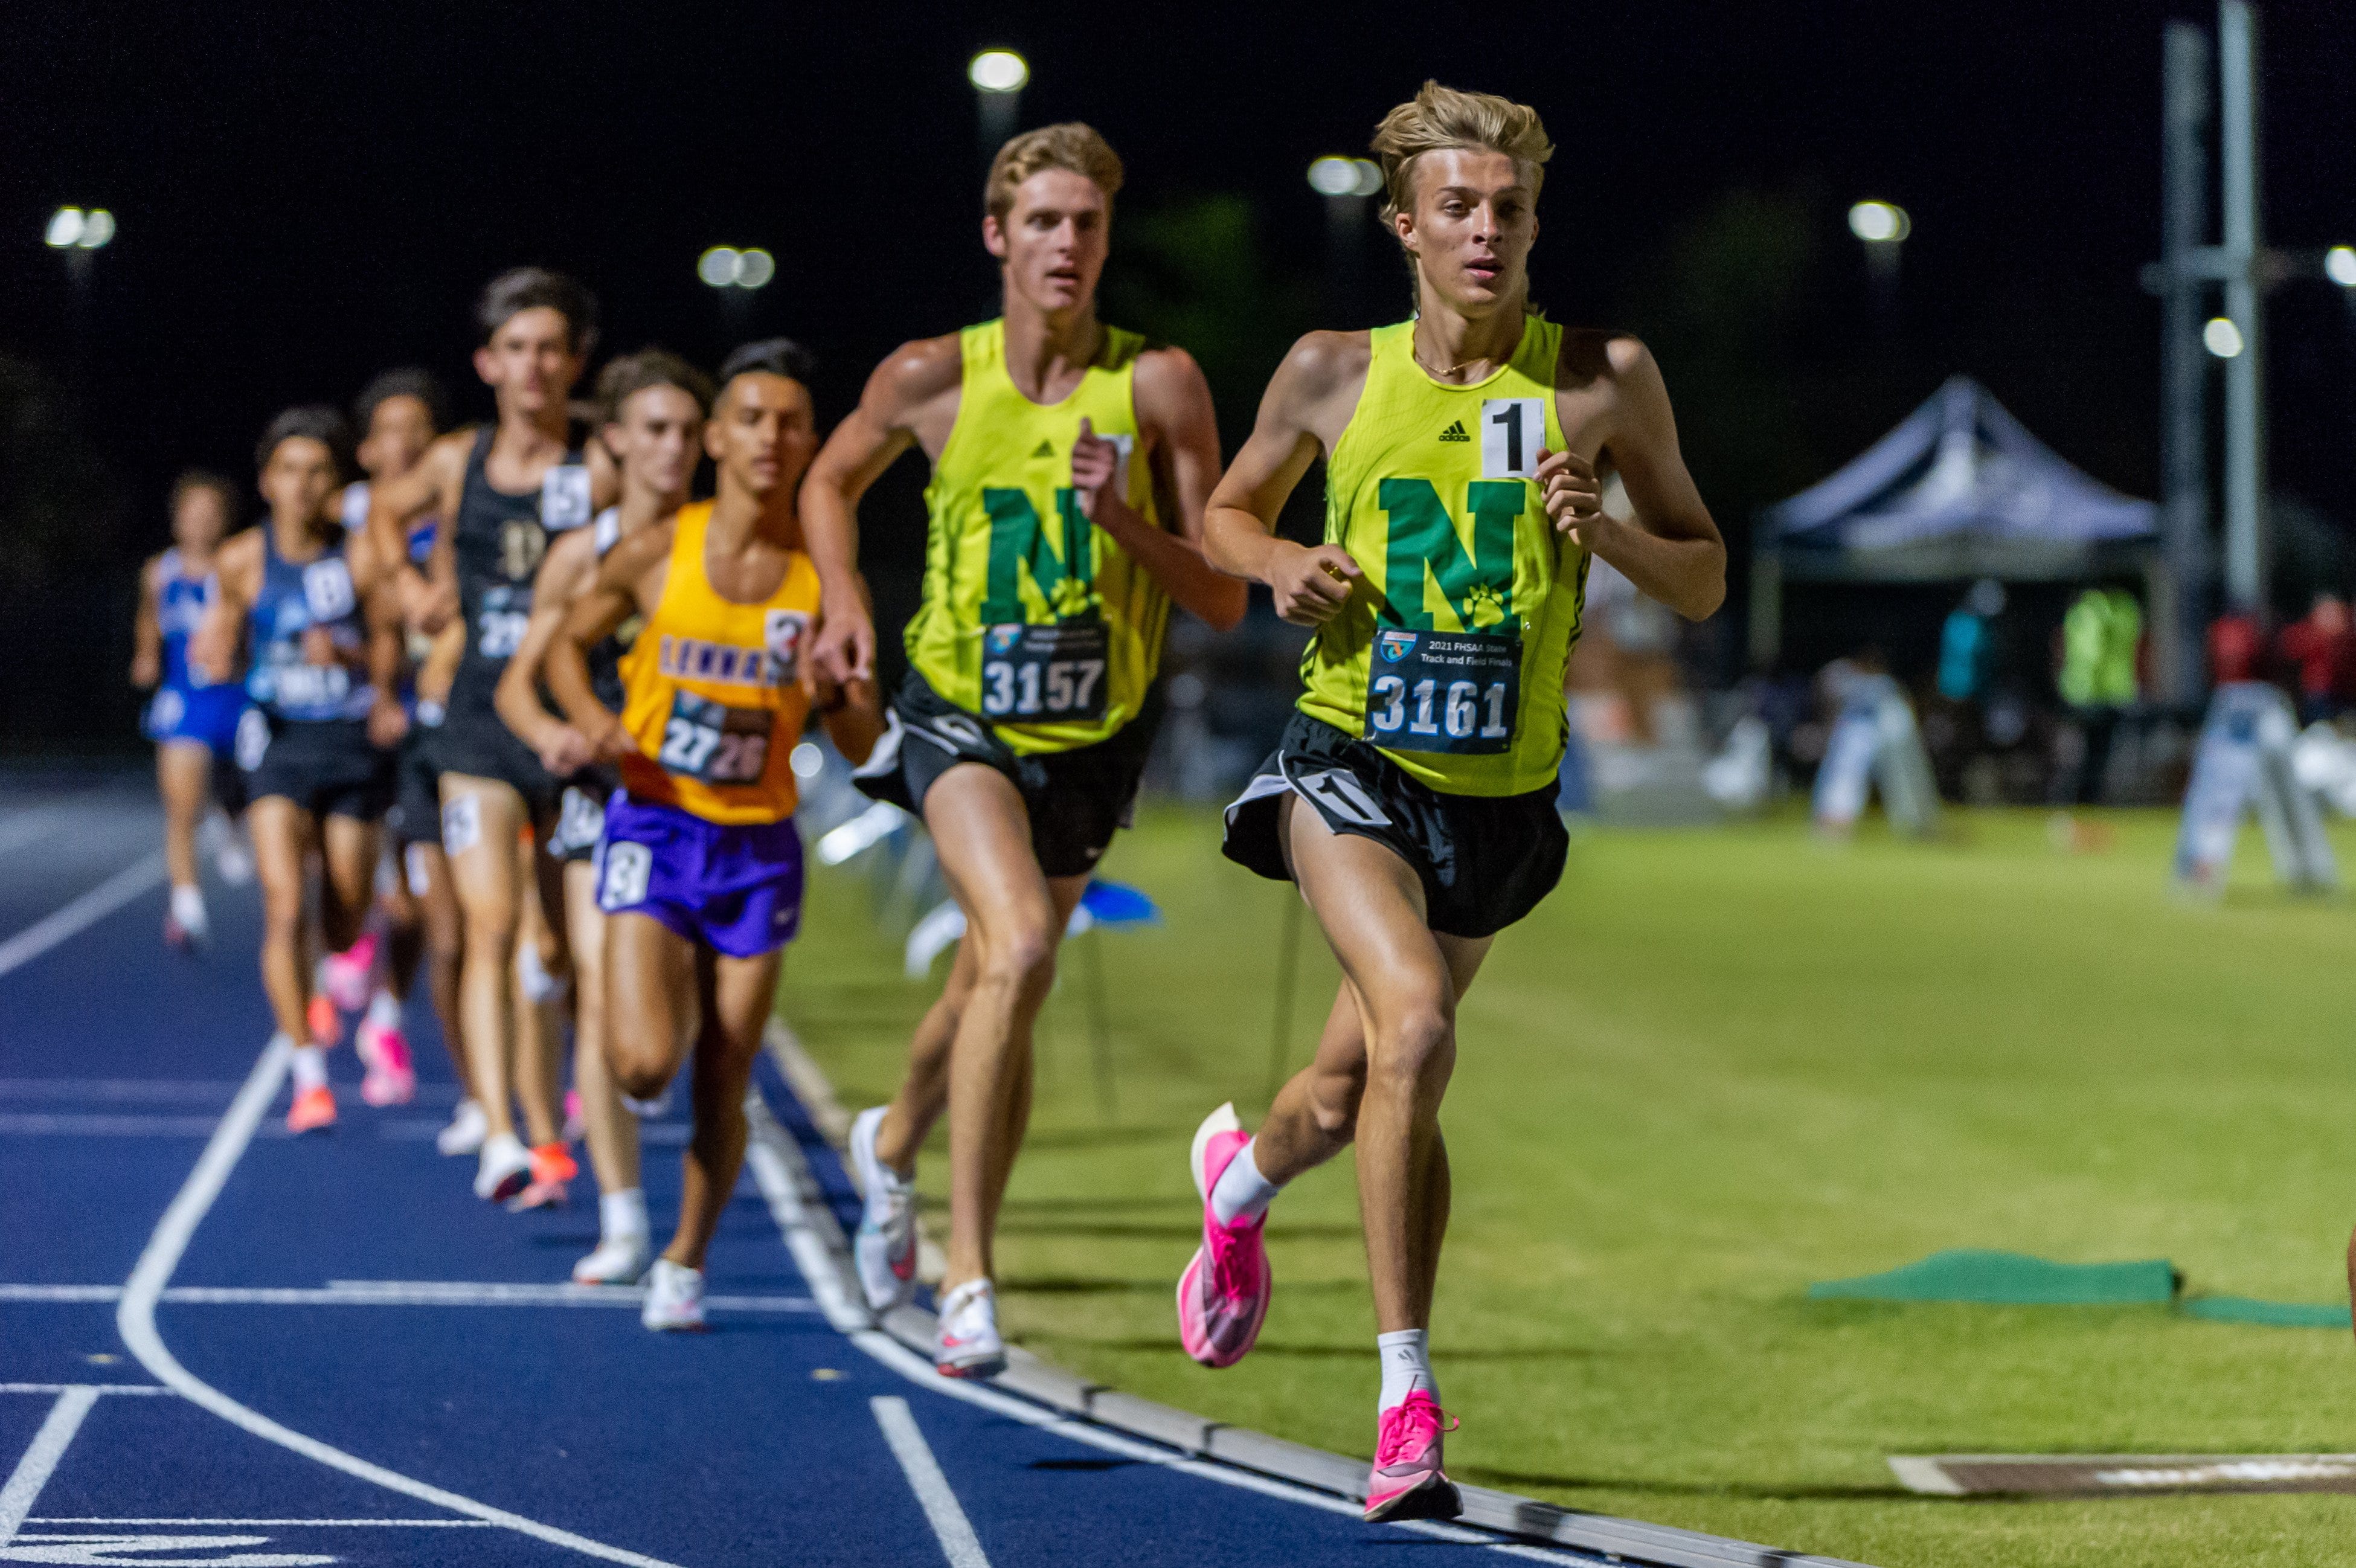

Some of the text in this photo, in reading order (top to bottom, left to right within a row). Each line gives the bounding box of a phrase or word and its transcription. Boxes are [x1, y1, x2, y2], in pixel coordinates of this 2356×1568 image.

[1439, 434, 1471, 442] adidas
[1492, 403, 1523, 471] 1
[980, 488, 1098, 625] N
[1377, 478, 1526, 635] N
[1421, 654, 1444, 663] Track
[1446, 656, 1464, 664] and
[1466, 657, 1486, 666] Field
[1429, 641, 1452, 651] 2021
[1454, 642, 1484, 652] FHSAA
[984, 659, 1105, 714] 3157
[1369, 675, 1509, 739] 3161
[1316, 774, 1373, 820] 1
